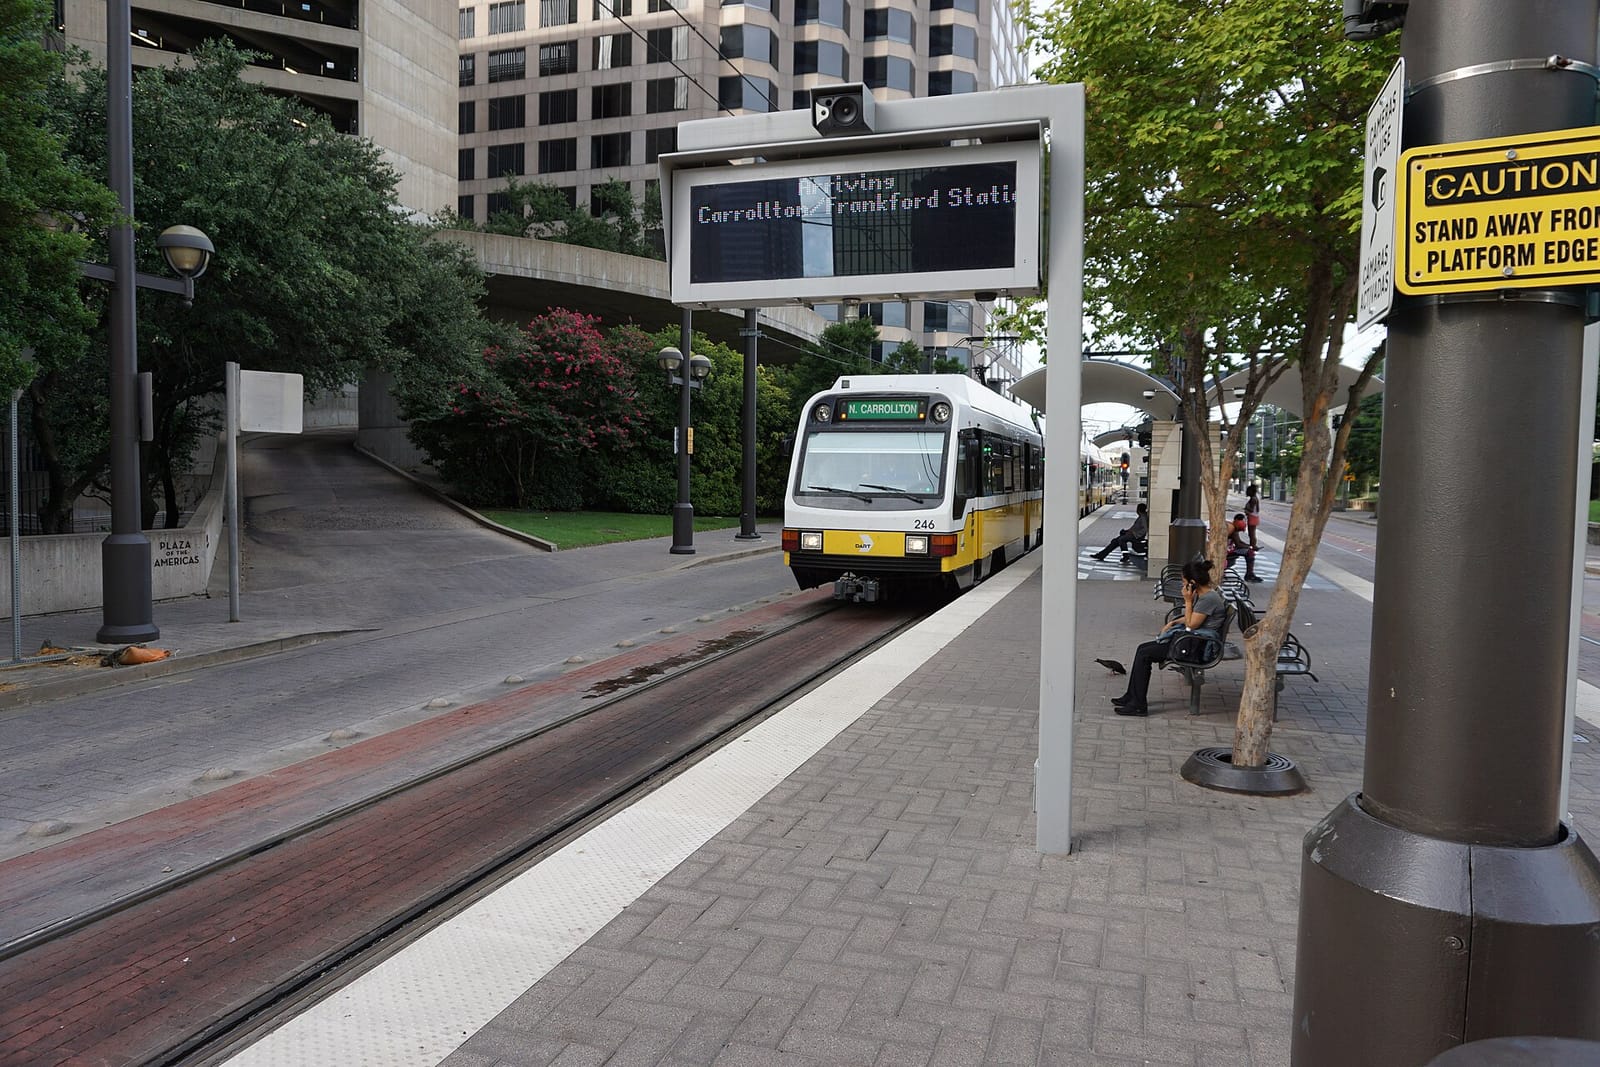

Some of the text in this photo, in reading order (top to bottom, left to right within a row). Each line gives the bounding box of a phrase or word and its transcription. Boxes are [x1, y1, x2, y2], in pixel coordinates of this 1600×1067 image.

[1370, 89, 1396, 147] CAMERAS
[1380, 124, 1391, 157] USE
[1431, 158, 1598, 200] CAUTION
[1415, 216, 1478, 244] STAND
[1485, 210, 1543, 238] AWAY
[1427, 237, 1599, 273] PLATFORM EDGE
[1360, 270, 1389, 311] ACTIVADAS
[849, 404, 917, 414] N. CARROLLTON
[914, 519, 935, 530] 246
[154, 556, 199, 567] AMERICAS
[160, 541, 191, 550] PLAZA
